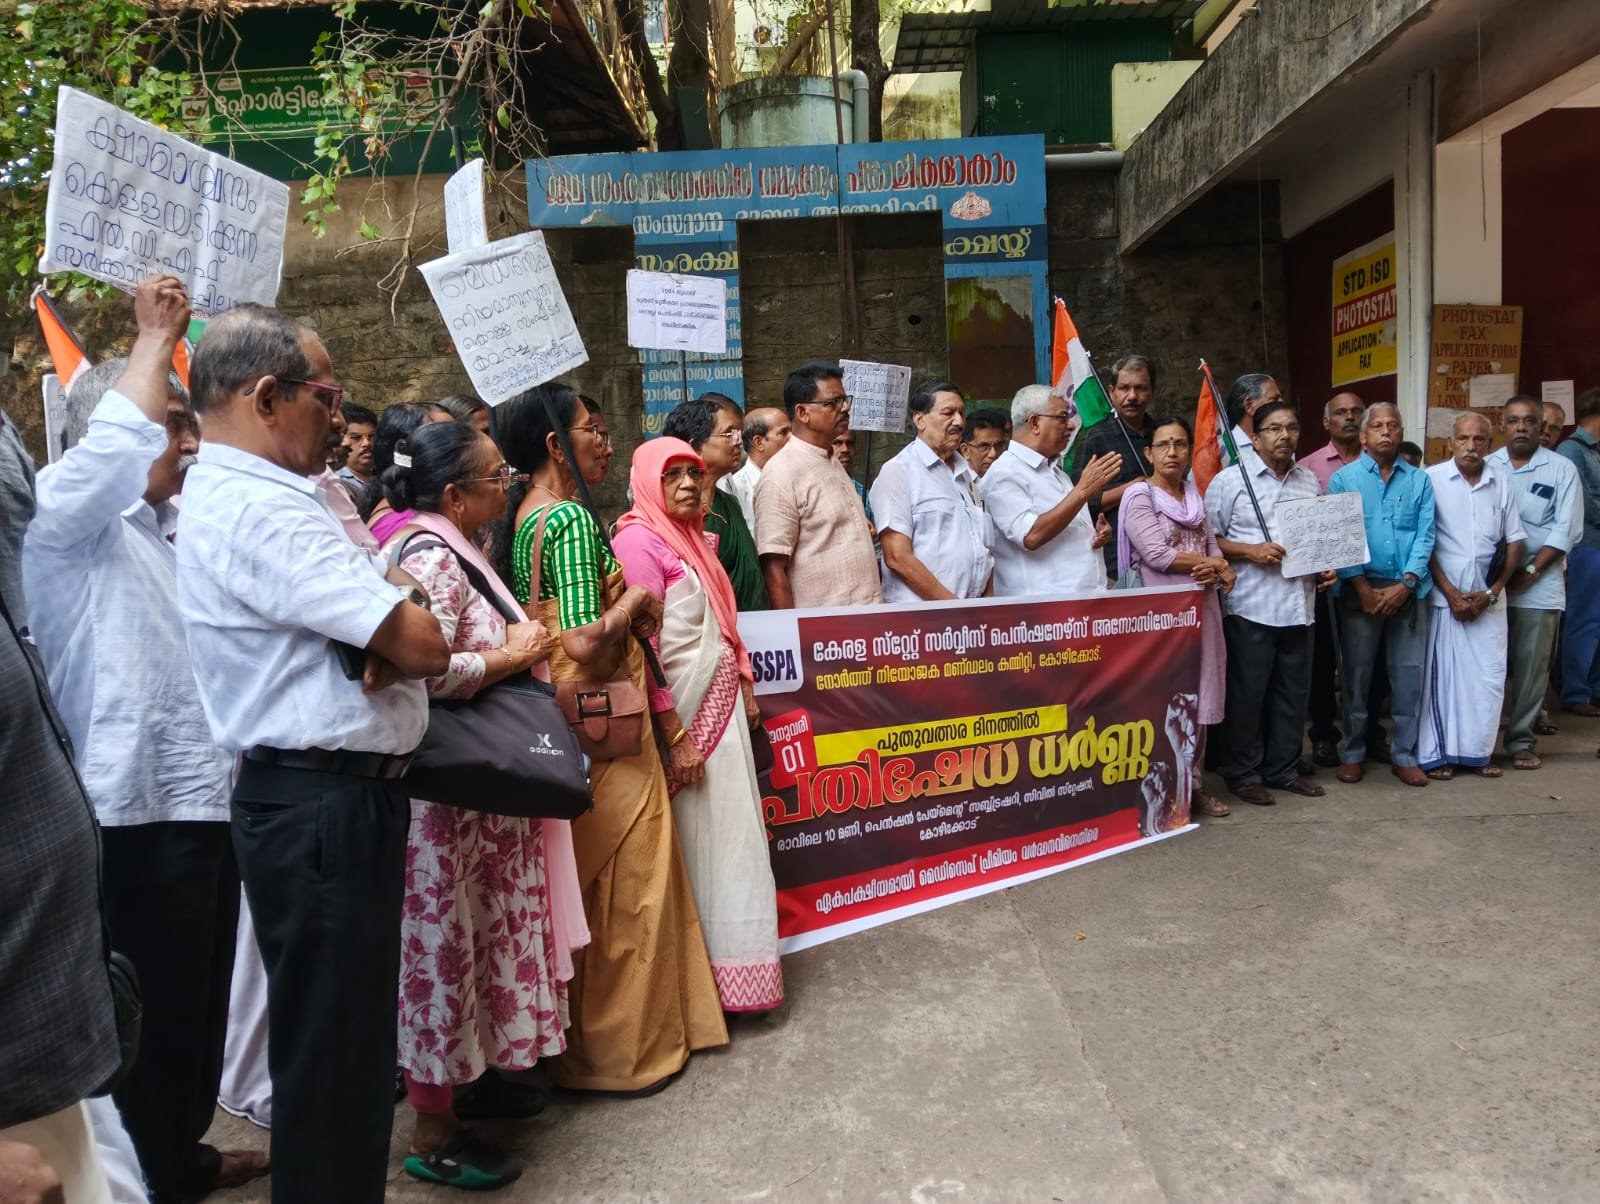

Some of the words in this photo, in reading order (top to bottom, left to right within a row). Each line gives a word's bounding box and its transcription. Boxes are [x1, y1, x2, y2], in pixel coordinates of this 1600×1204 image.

[1442, 308, 1516, 324] PHOTOSTAT
[1338, 331, 1378, 358] APPLICATION
[1459, 326, 1488, 340] FAX
[1359, 353, 1373, 370] FAX
[1433, 343, 1490, 358] APPLICATION
[1491, 344, 1519, 358] FORM
[813, 638, 868, 662] കേരള
[748, 649, 798, 683] SSPA
[816, 665, 874, 691] നോർത്ത്
[876, 663, 940, 685] നിയോജക
[944, 656, 994, 678] മണ്ഡലം
[877, 723, 968, 752] പുതുവത്സര
[973, 710, 1040, 738] ദിനത്തിൽ
[781, 741, 806, 773] 01
[1029, 715, 1155, 785] ധർണ്ണ
[777, 832, 822, 852] രാവിലെ
[825, 829, 836, 843] 10
[865, 811, 914, 833] പെൻഷൻ
[919, 816, 980, 842] കോഴിക്കോട്
